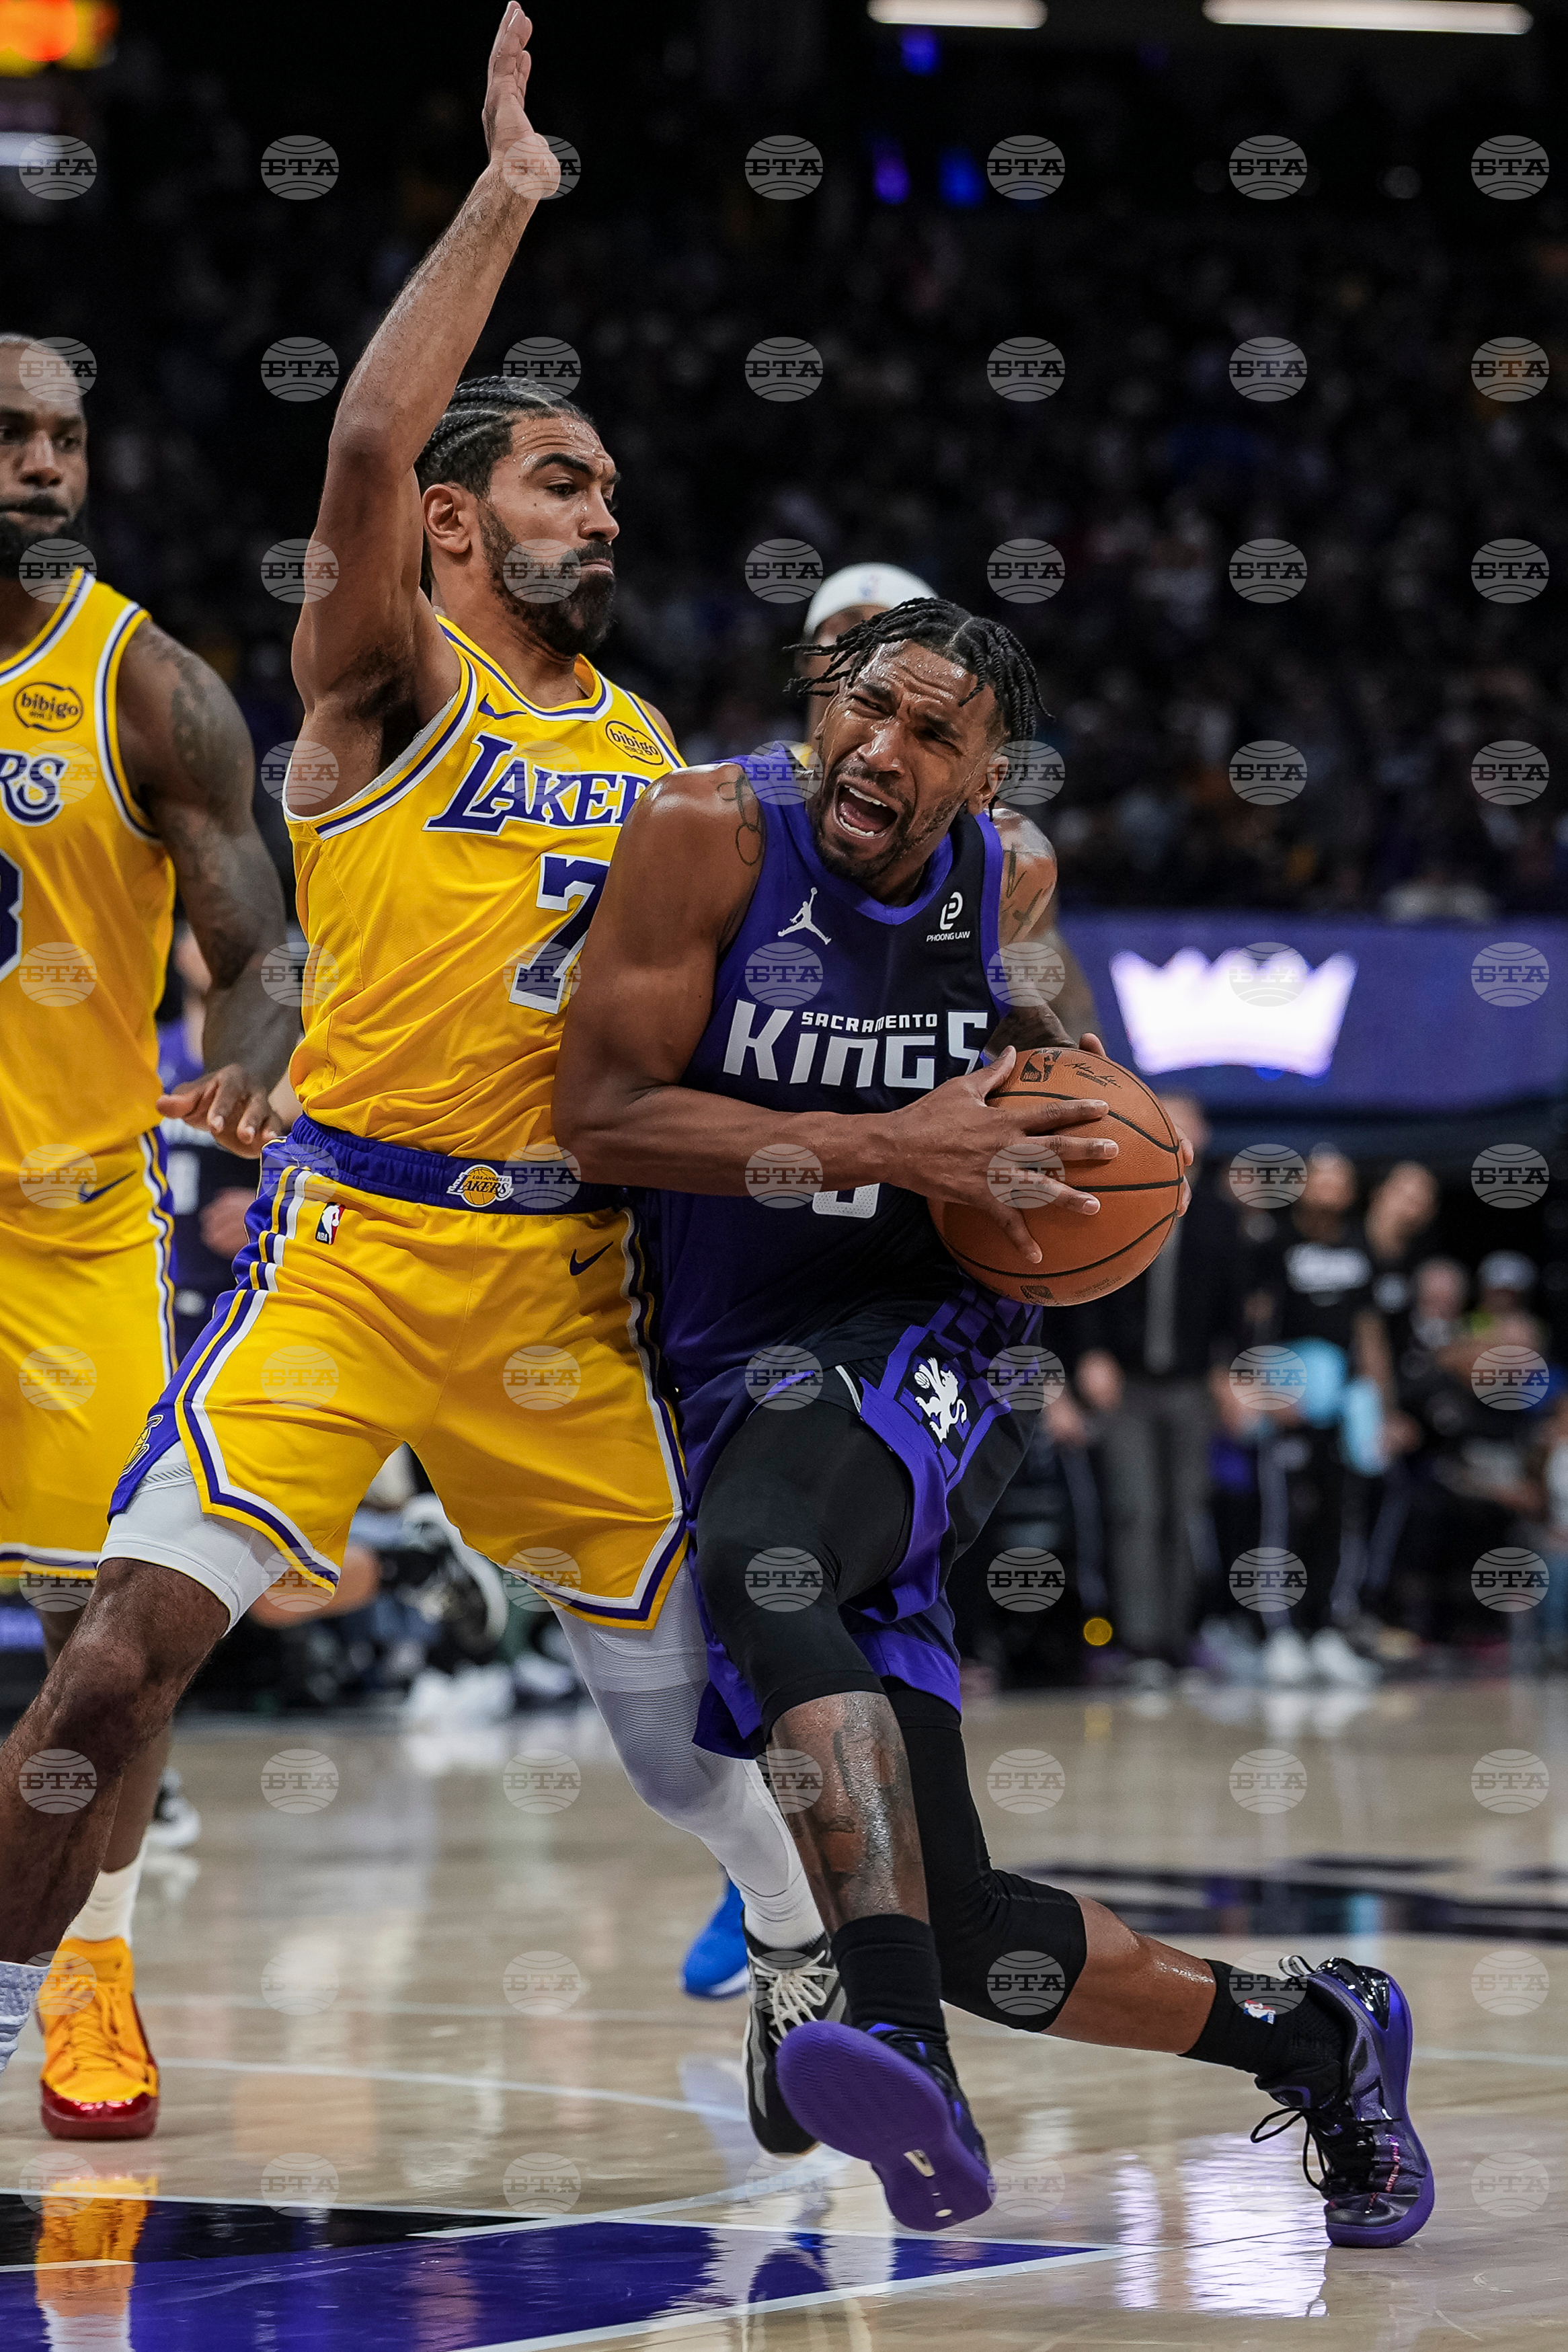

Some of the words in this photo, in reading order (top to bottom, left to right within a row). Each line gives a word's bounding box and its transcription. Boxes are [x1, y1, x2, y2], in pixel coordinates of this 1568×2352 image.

[22, 693, 79, 719] bibigo
[609, 729, 659, 756] bibigo
[510, 853, 611, 1014] 7
[926, 932, 954, 942] PHOONG
[955, 931, 970, 939] LAW
[801, 1011, 937, 1033] SACRAMENTO
[446, 1173, 514, 1200] LAKERS
